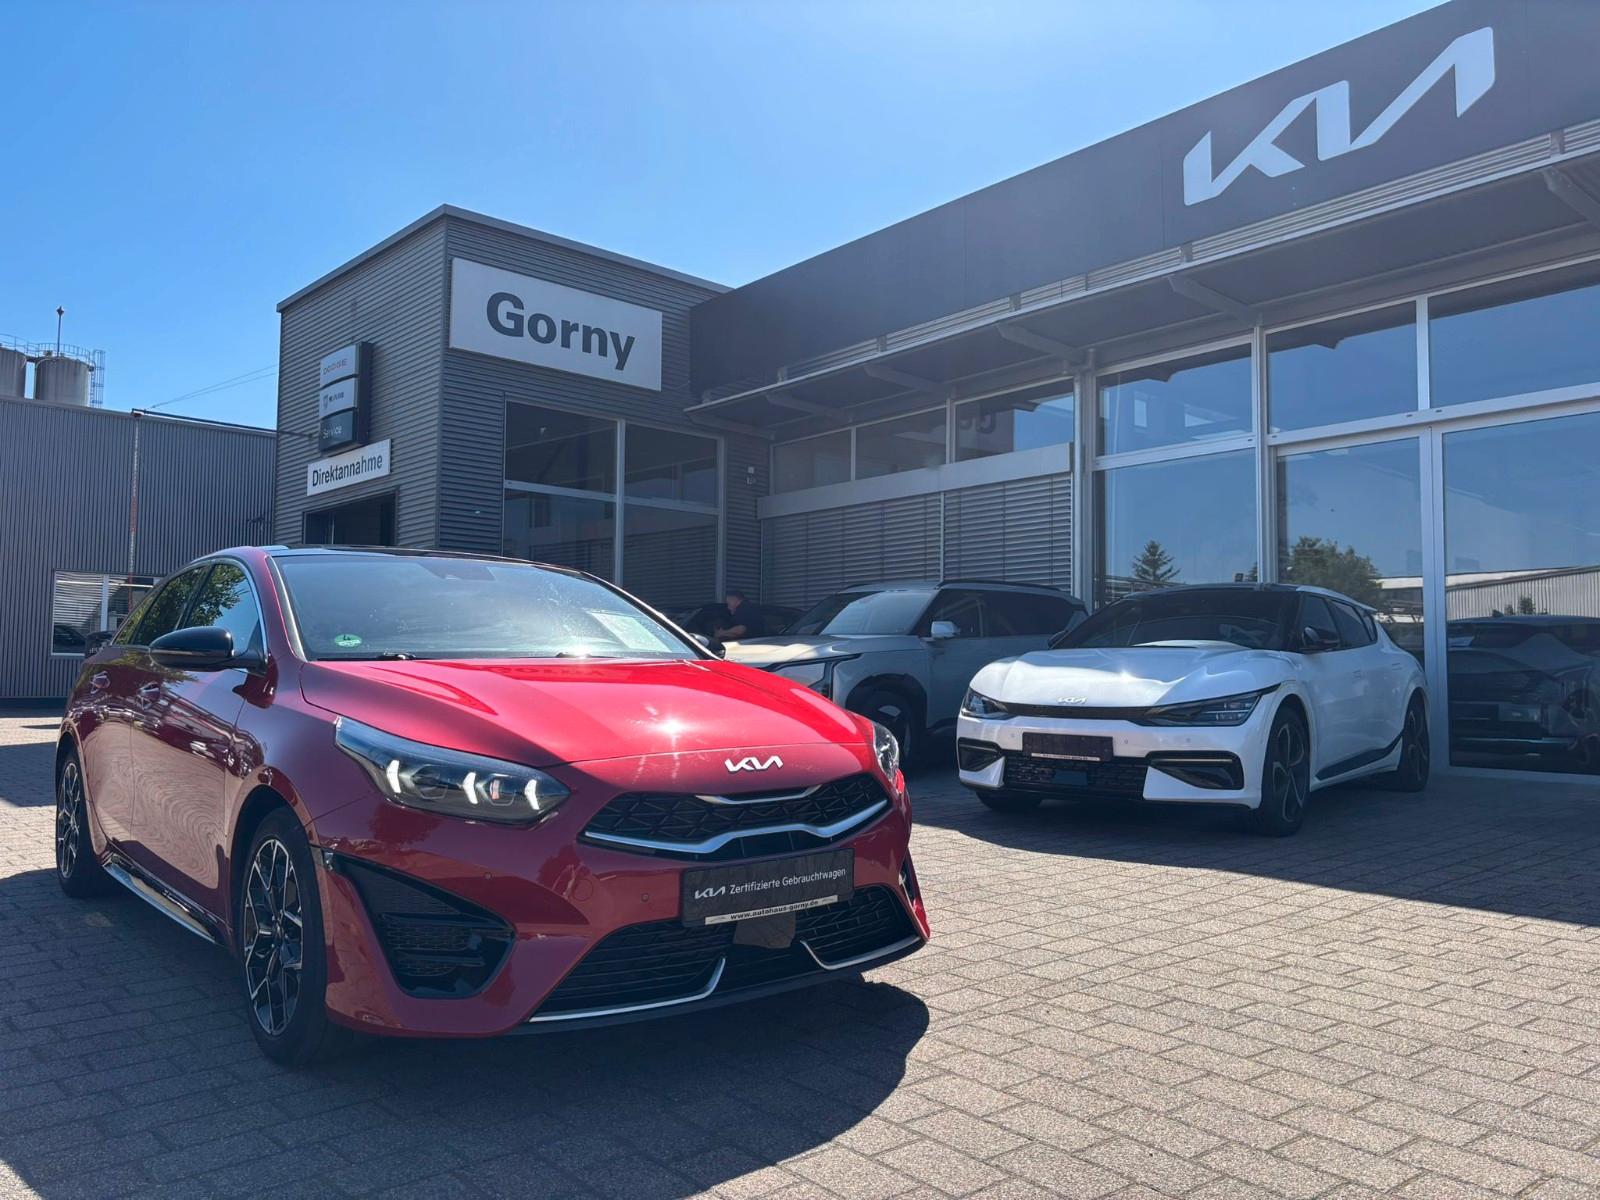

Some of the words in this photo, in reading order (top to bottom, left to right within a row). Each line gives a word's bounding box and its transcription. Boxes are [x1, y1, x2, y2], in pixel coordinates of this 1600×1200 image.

[486, 291, 636, 371] Gorny
[312, 454, 383, 487] Direktannahme
[730, 879, 781, 895] Zertifizierte
[782, 868, 846, 887] Gebrauchtwagen
[730, 900, 819, 920] www.autohaus-gorny.de
